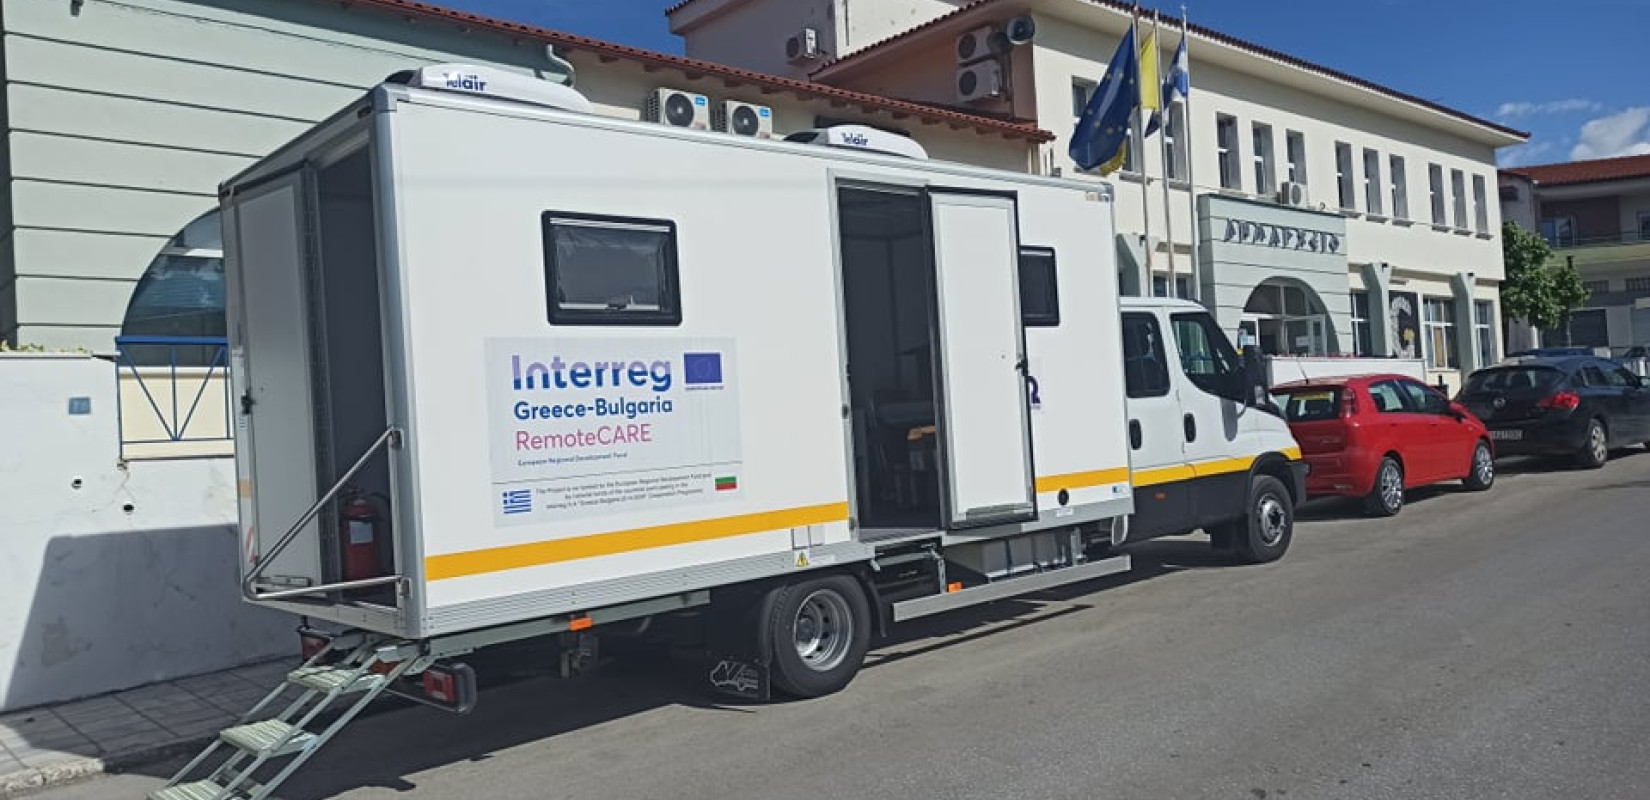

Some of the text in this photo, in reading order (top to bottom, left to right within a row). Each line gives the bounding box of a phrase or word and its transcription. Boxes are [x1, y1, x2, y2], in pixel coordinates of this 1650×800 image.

[511, 354, 672, 392] Interreg
[514, 395, 673, 420] Greece-Bulgaria
[516, 423, 653, 451] RemoteCARE
